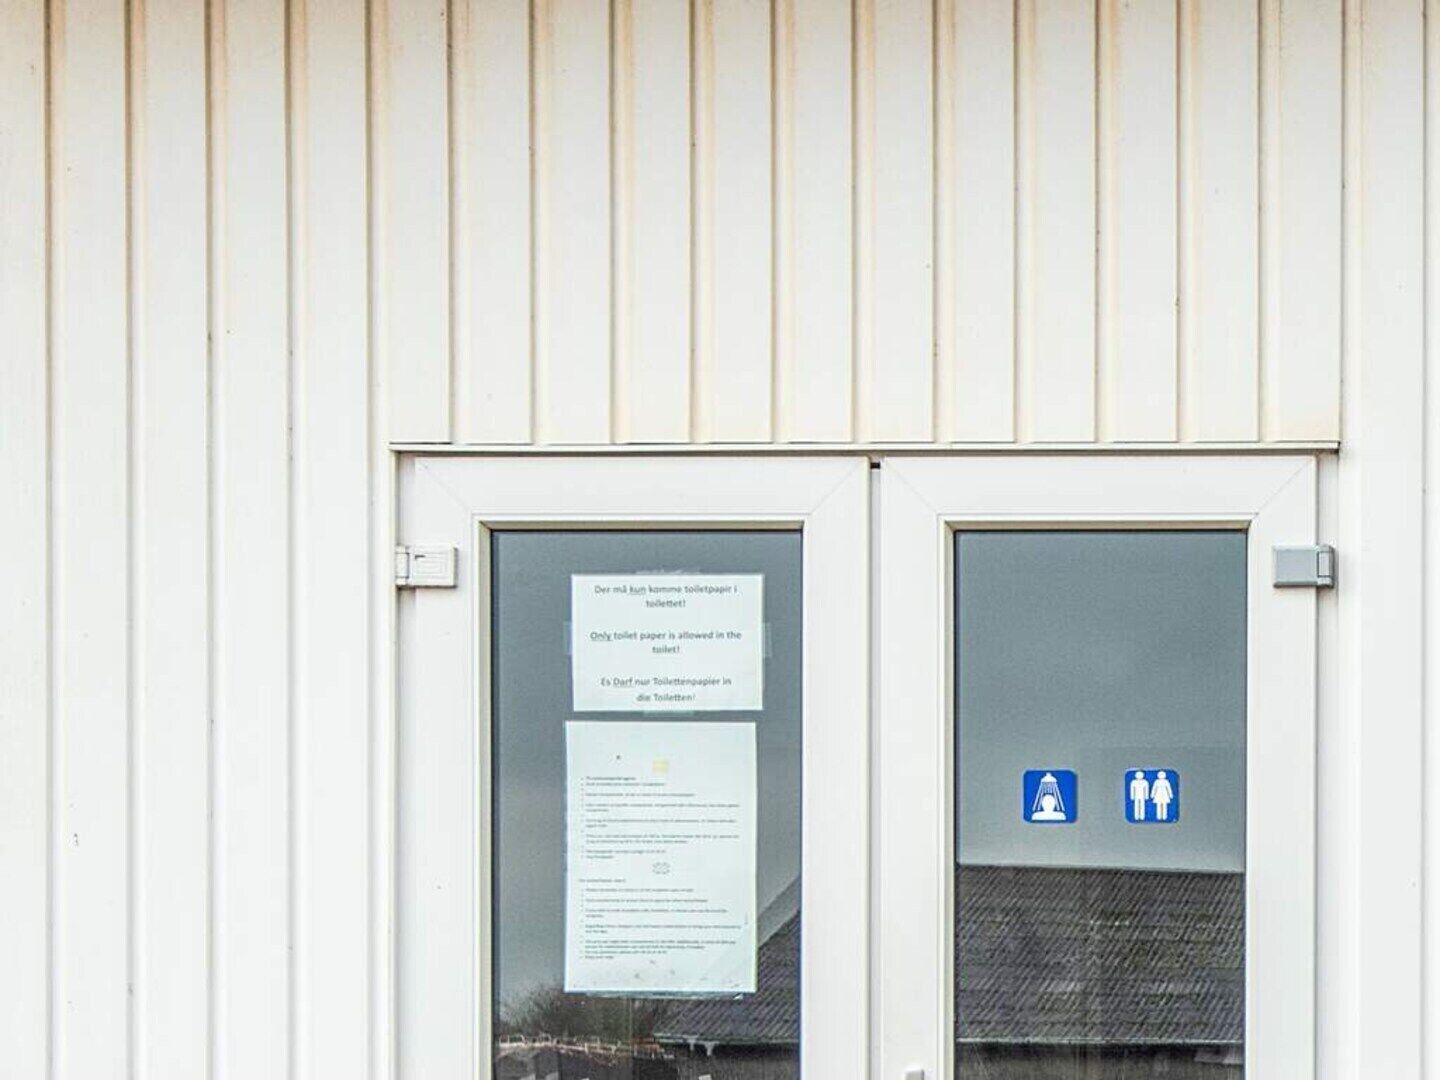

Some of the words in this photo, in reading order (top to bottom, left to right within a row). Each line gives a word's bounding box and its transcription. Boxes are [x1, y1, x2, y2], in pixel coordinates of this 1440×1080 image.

[594, 585, 610, 594] Der
[613, 585, 627, 593] må
[630, 585, 646, 595] kun
[649, 585, 682, 594] komme
[684, 585, 731, 594] toiletpapir
[646, 600, 686, 608] toilettet!
[590, 631, 612, 641] Only
[613, 631, 638, 640] toilet
[640, 633, 666, 641] paper
[668, 632, 676, 640] is
[678, 631, 714, 640] allowed
[715, 632, 725, 640] in
[726, 631, 742, 640] the
[652, 645, 680, 653] toilet!
[601, 677, 611, 686] Es
[613, 677, 633, 688] Darf
[653, 676, 720, 687] Toilettenpapier
[722, 676, 732, 686] in
[636, 693, 651, 702] die
[653, 692, 696, 702] Toiletten!
